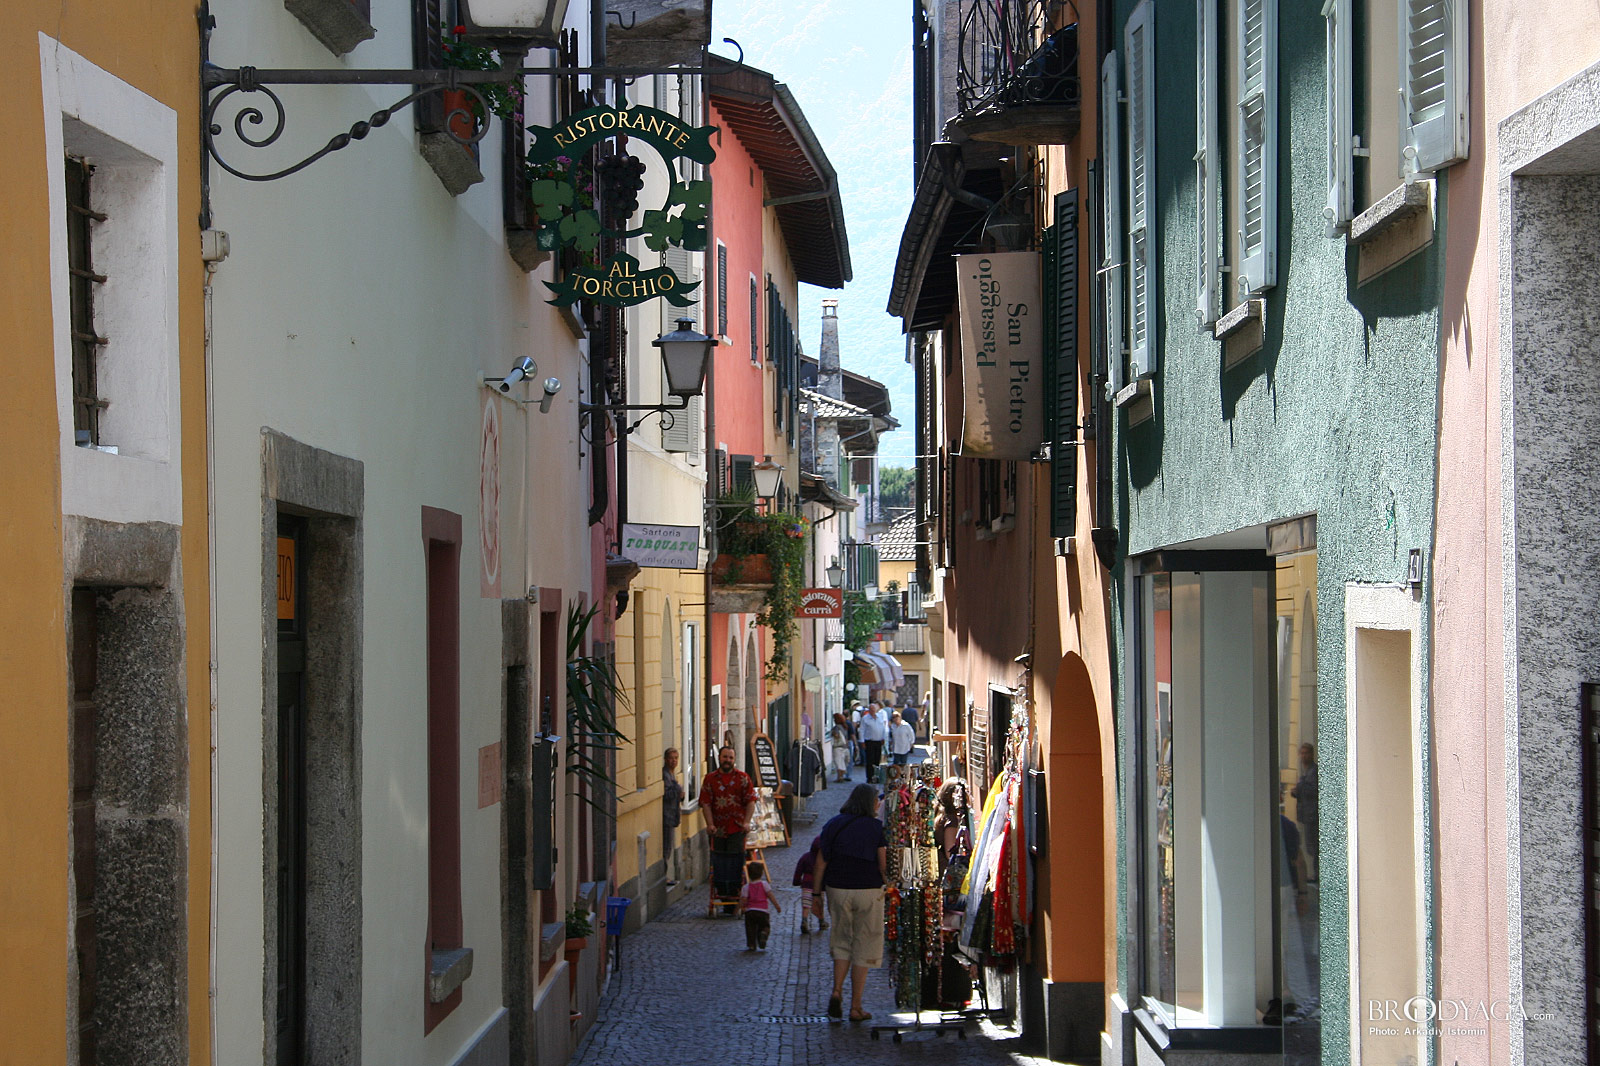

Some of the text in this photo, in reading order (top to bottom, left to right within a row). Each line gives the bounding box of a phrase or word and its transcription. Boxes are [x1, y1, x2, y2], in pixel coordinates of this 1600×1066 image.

[553, 111, 691, 150] RISTORANTE
[608, 261, 636, 278] AL
[572, 273, 675, 298] TORCHIO
[972, 258, 1001, 369] Passaggio
[1007, 303, 1030, 434] San Pietro
[626, 538, 697, 552] TORQUATO
[642, 527, 681, 538] Sartoria
